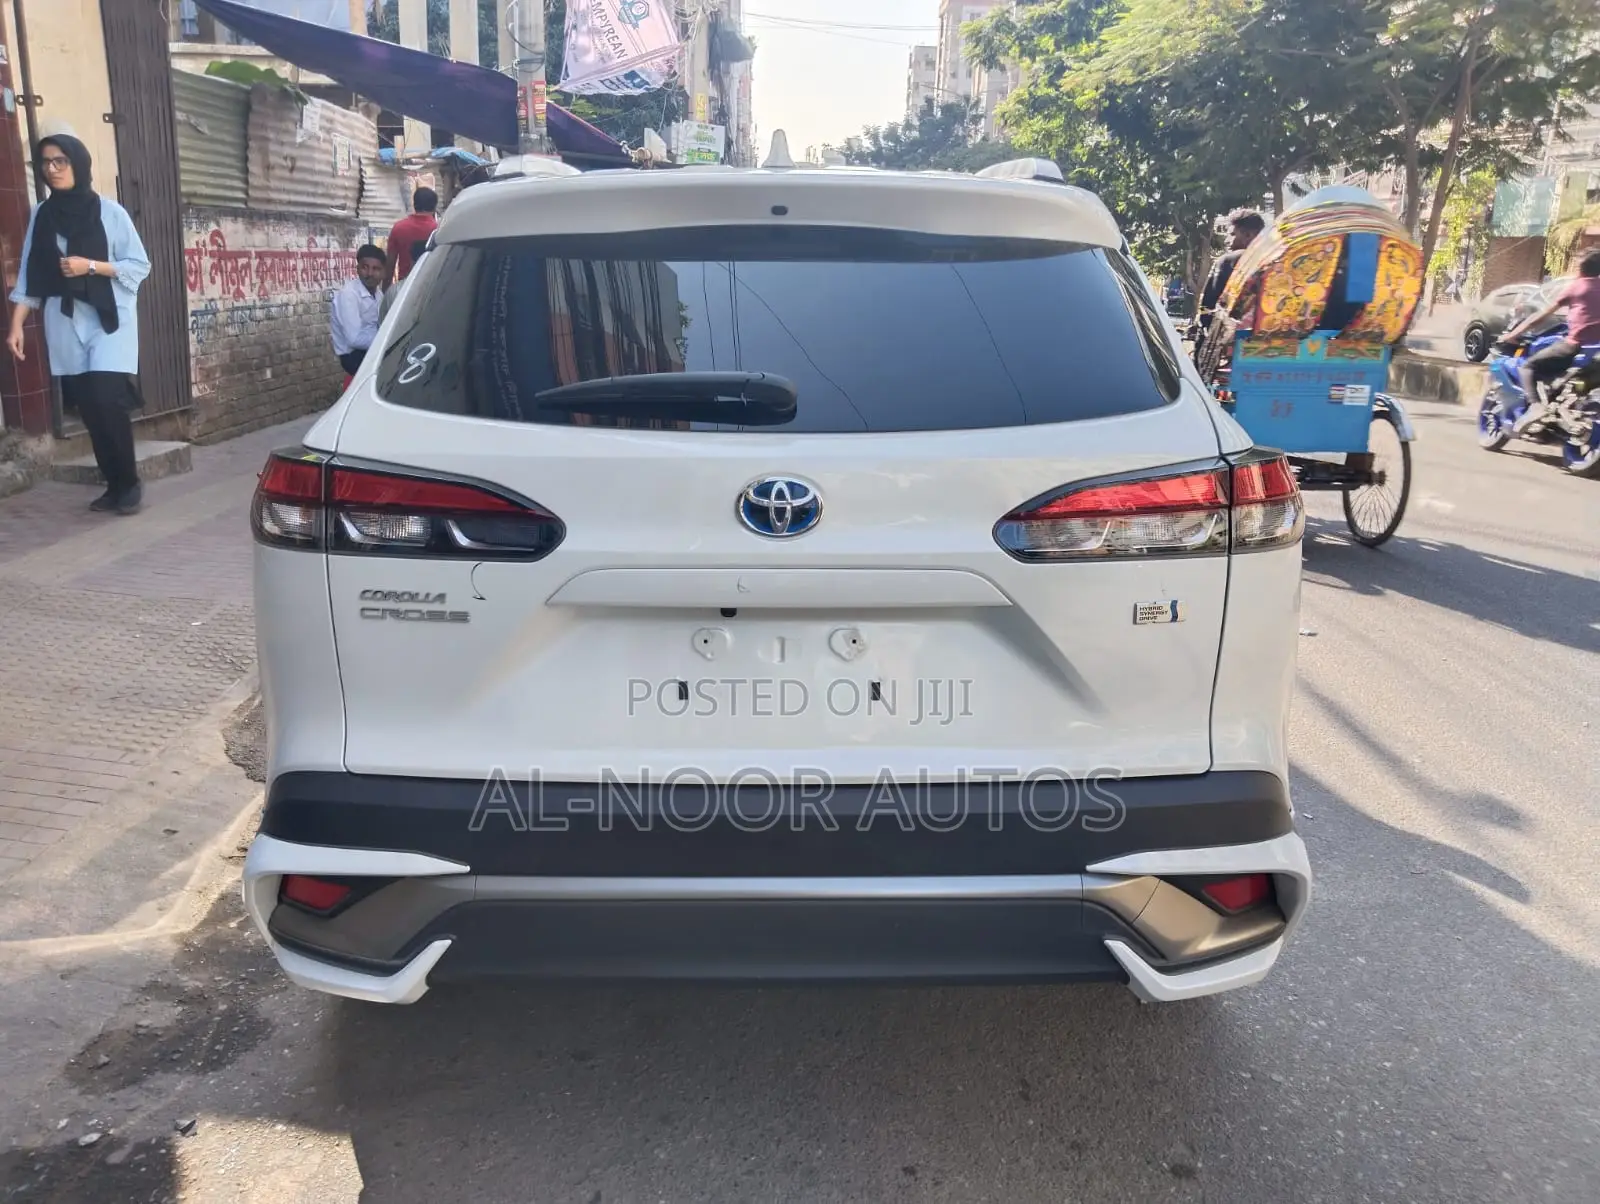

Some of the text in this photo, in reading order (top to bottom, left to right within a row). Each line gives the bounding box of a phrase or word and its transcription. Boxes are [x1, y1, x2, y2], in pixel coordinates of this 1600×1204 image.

[591, 0, 628, 59] MPYREAN
[360, 589, 447, 604] COROLLA
[360, 607, 471, 623] CROSS
